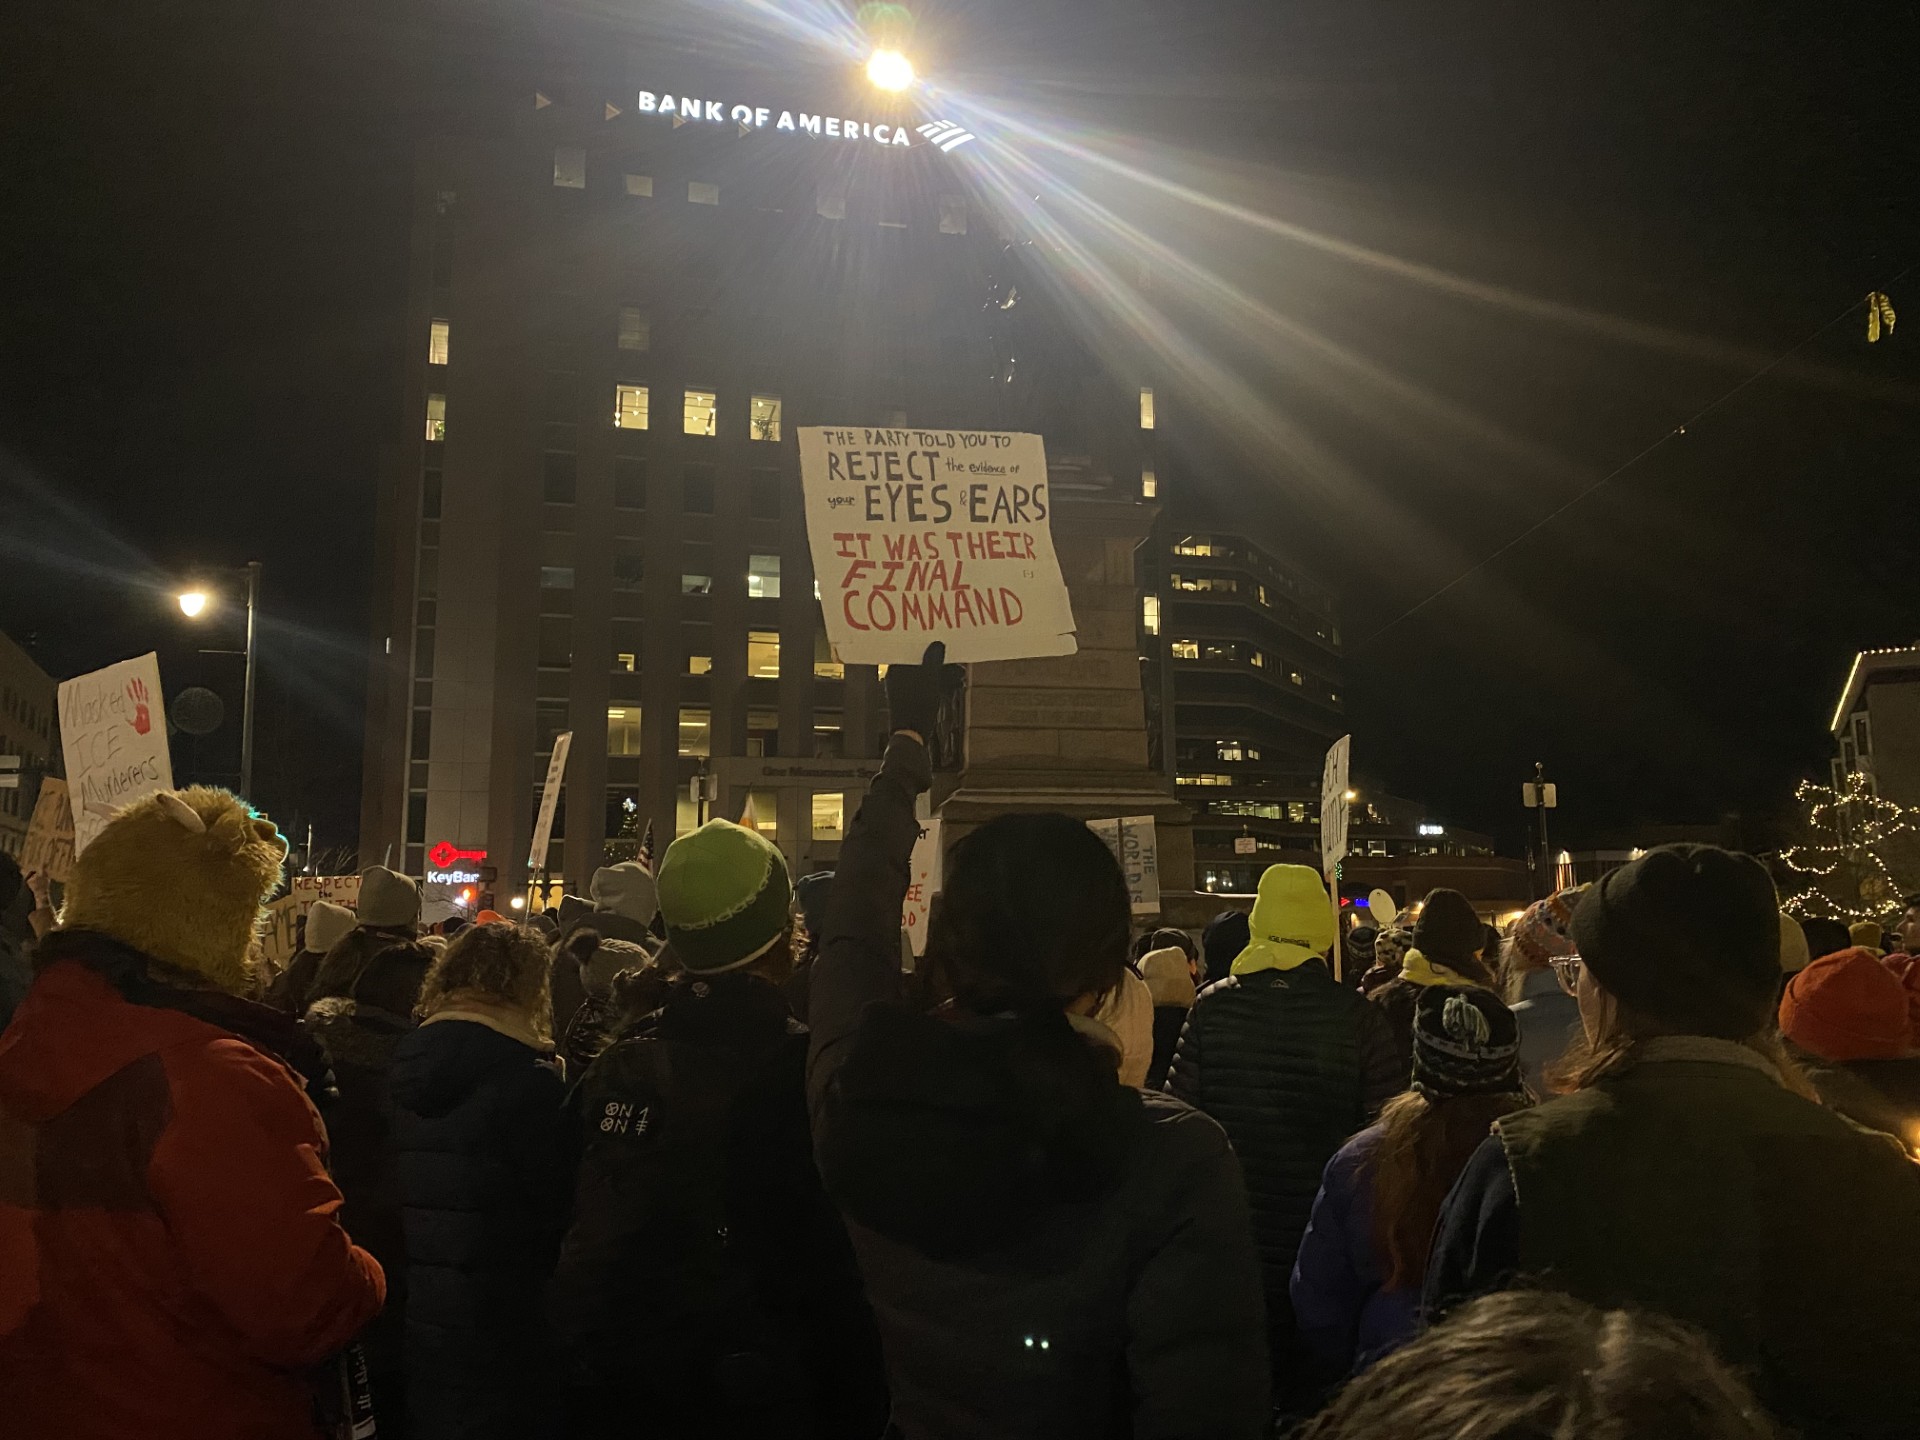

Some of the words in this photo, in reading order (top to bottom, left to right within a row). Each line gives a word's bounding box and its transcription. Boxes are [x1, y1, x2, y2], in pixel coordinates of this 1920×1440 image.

[638, 91, 724, 122] BANK
[731, 104, 770, 127] OF
[776, 111, 911, 147] AMERICA
[823, 431, 855, 446] THE
[864, 430, 910, 447] PARTY
[913, 432, 955, 448] TOLD
[959, 434, 987, 449] YOU
[990, 435, 1011, 448] TO
[828, 451, 940, 482] REJECT
[945, 457, 964, 472] the
[969, 462, 1006, 474] evidence
[828, 496, 855, 509] your
[865, 483, 952, 524] EYES
[960, 490, 967, 507] &
[969, 484, 1046, 524] EARS
[833, 532, 871, 560] IT
[883, 532, 940, 561] WAS
[946, 531, 1037, 560] THEIR
[841, 560, 971, 592] FINAL
[843, 587, 1023, 631] COMMAND
[64, 680, 126, 728] Masked
[71, 725, 122, 779] ICE
[81, 755, 159, 816] Murderers
[1124, 825, 1141, 884] WORLD
[1143, 846, 1154, 874] THE
[295, 878, 361, 890] RESPECT
[319, 890, 333, 898] the
